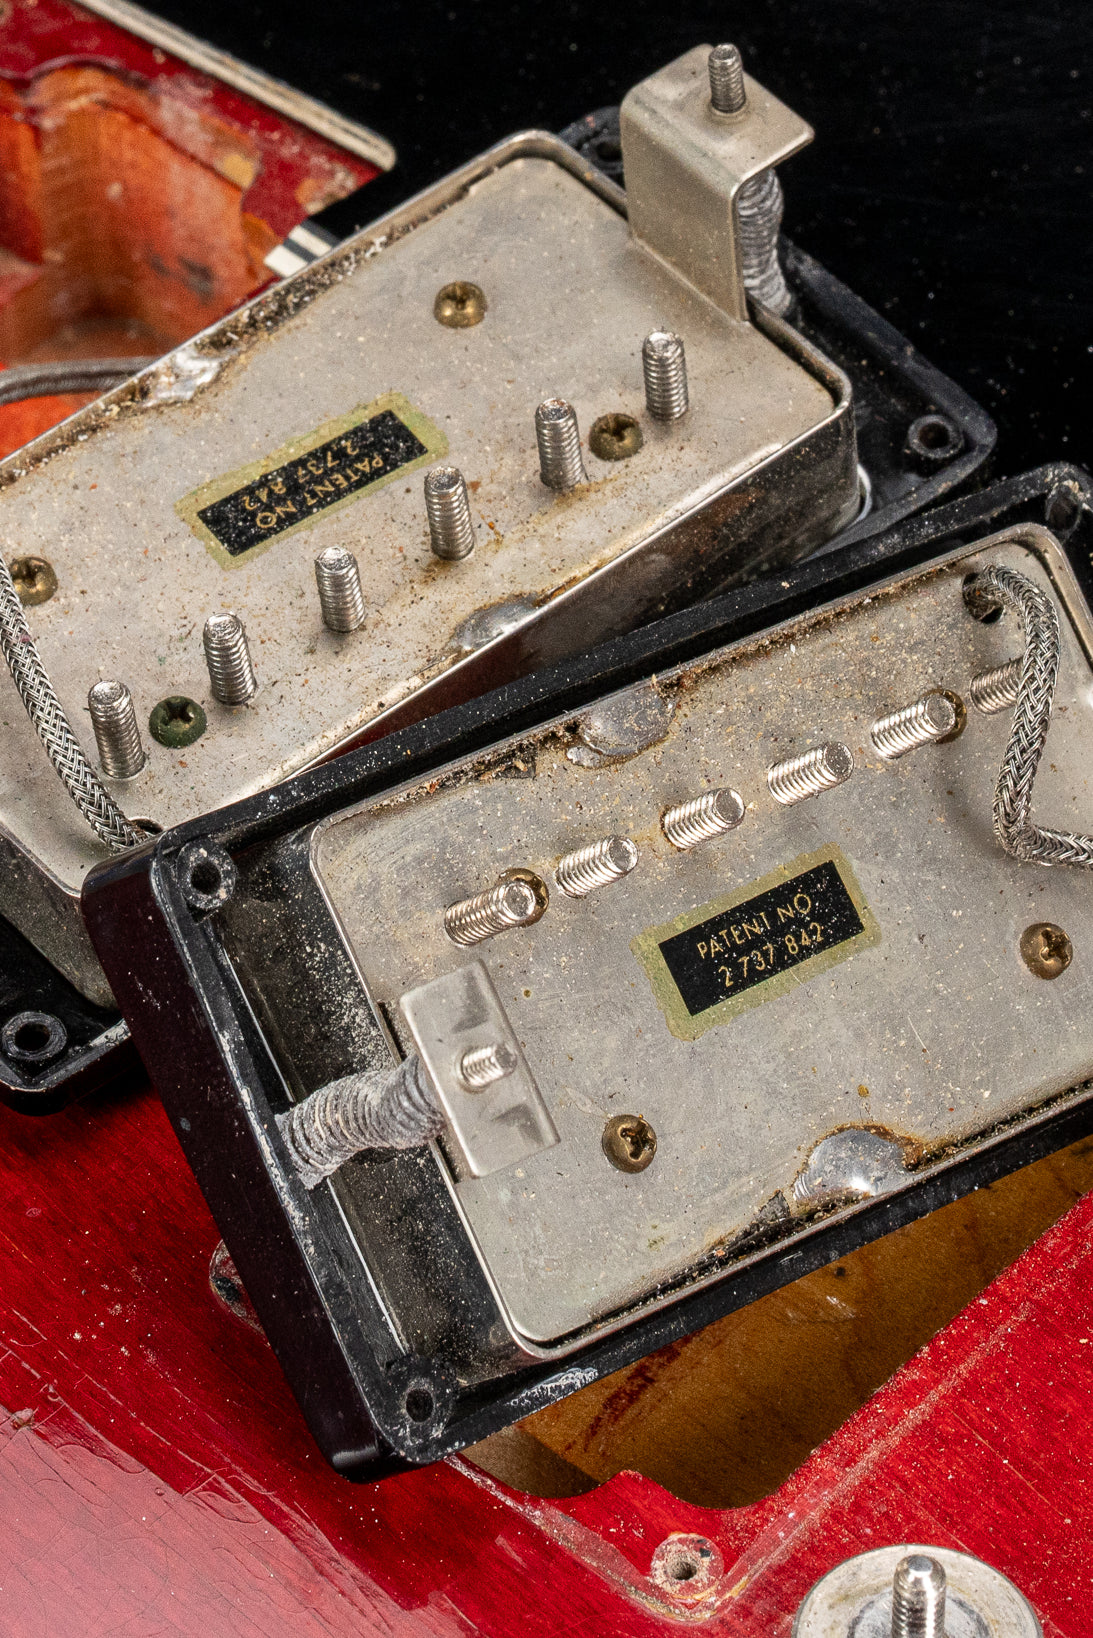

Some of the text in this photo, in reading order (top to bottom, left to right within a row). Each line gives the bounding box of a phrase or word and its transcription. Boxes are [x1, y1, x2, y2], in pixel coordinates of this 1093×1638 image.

[256, 452, 384, 528] PATENT NO
[696, 893, 812, 959] PATENT NO
